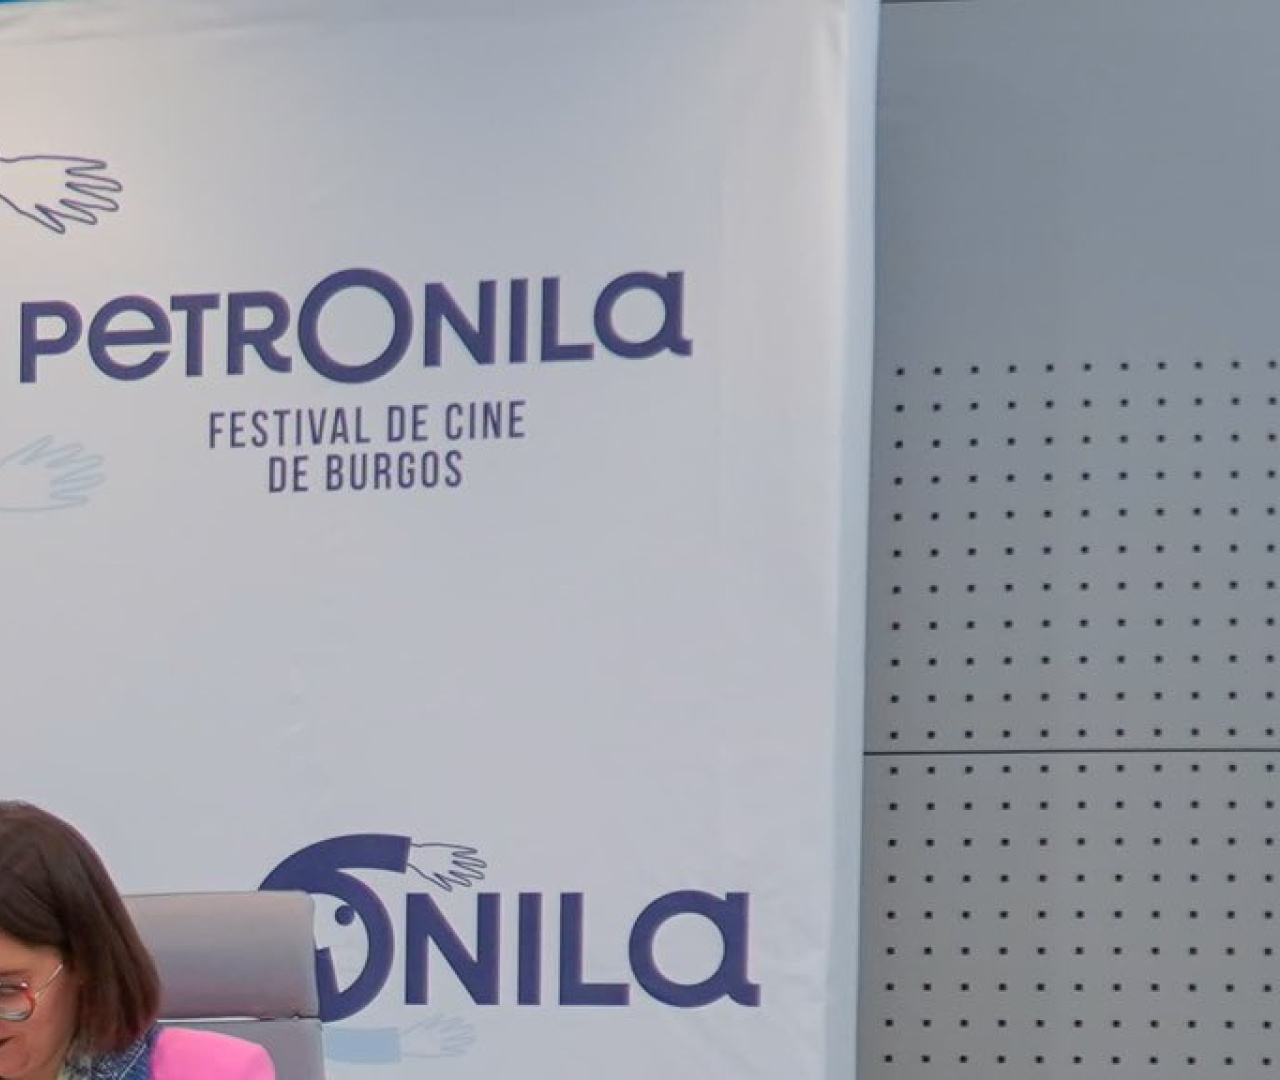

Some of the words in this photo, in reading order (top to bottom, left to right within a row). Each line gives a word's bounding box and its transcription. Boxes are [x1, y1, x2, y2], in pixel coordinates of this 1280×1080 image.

[208, 406, 372, 450] FESTIVAL
[385, 403, 429, 444] DE
[444, 399, 527, 443] CINE
[267, 454, 310, 495] DE
[324, 448, 463, 493] BURGOS
